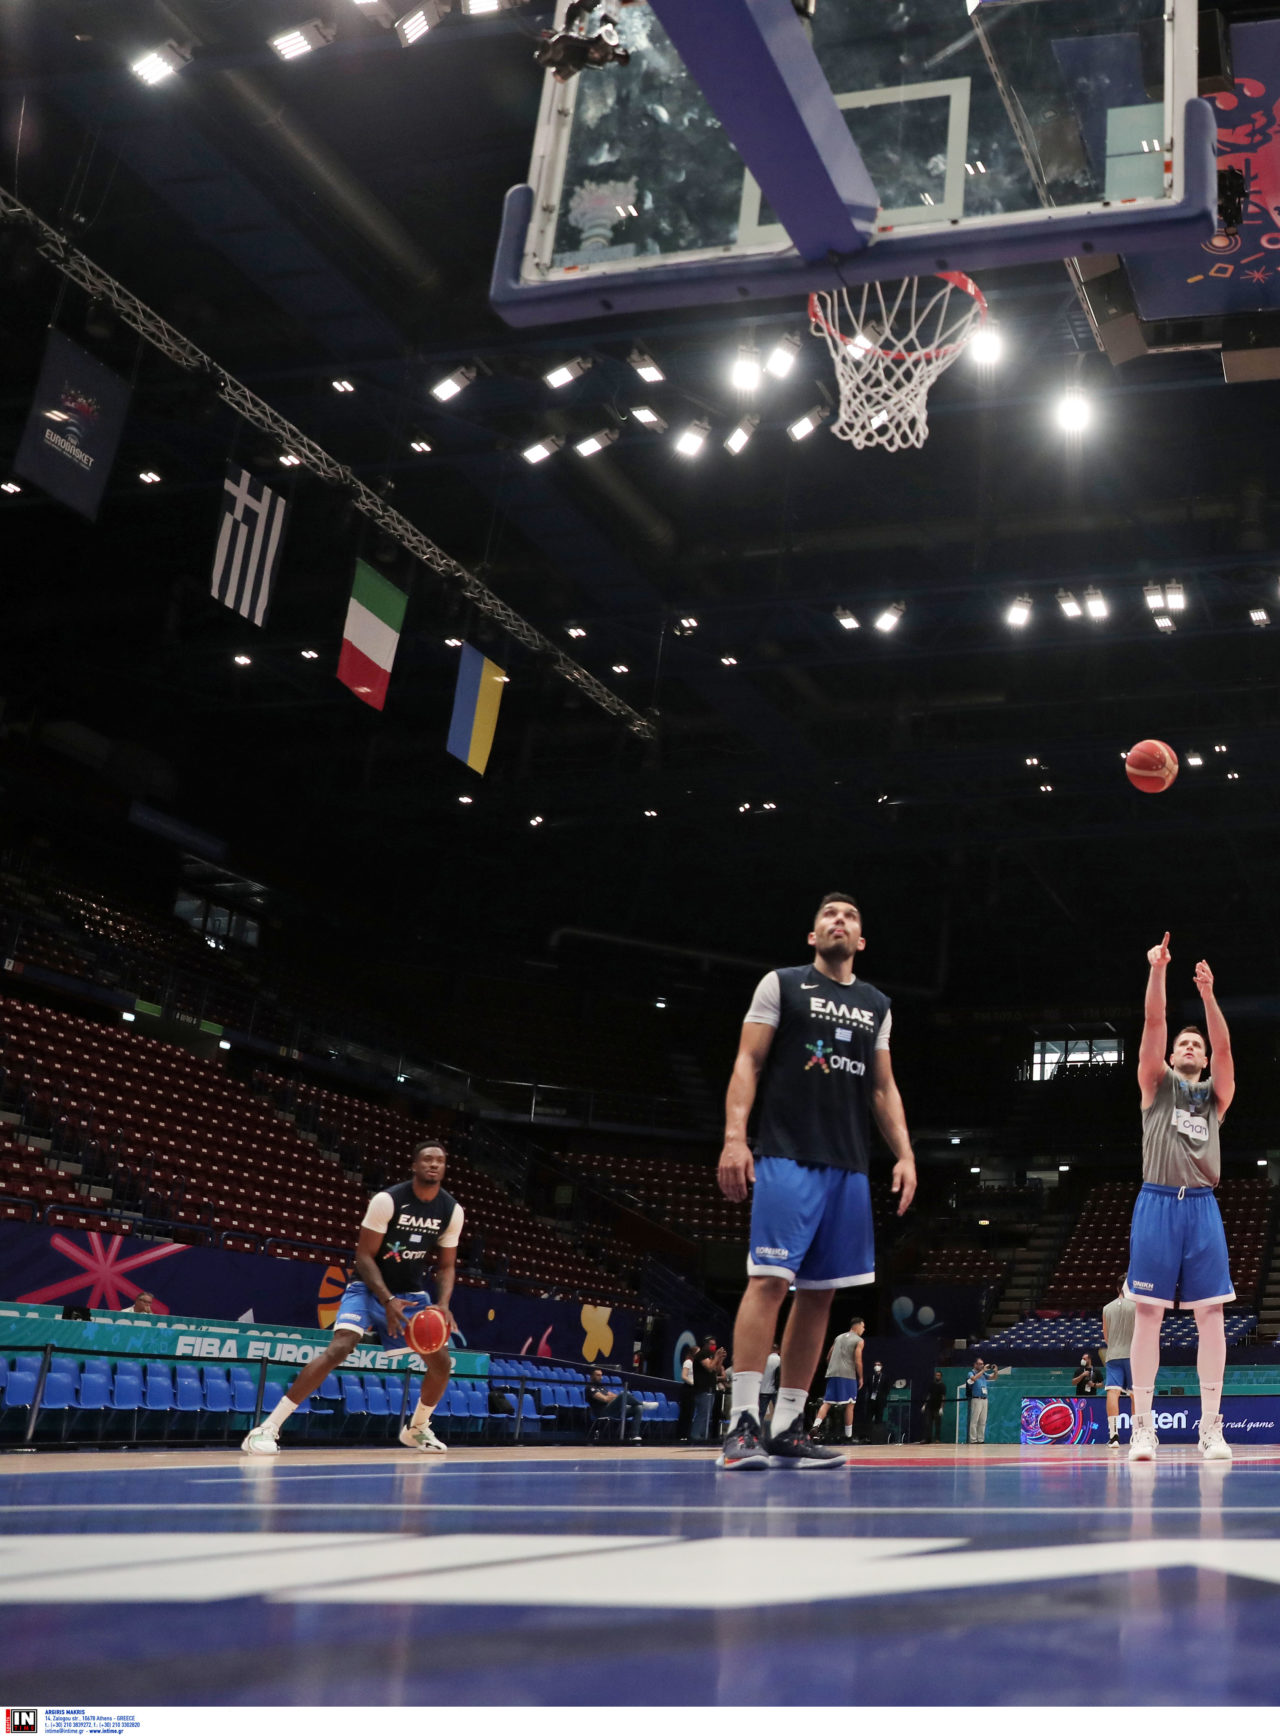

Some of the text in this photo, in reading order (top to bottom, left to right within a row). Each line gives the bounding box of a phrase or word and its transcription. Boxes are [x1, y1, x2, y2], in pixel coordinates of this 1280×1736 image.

[45, 428, 94, 467] EUROBASKET
[175, 1335, 238, 1359] FIBA
[1225, 1418, 1247, 1429] real
[1247, 1419, 1274, 1431] game
